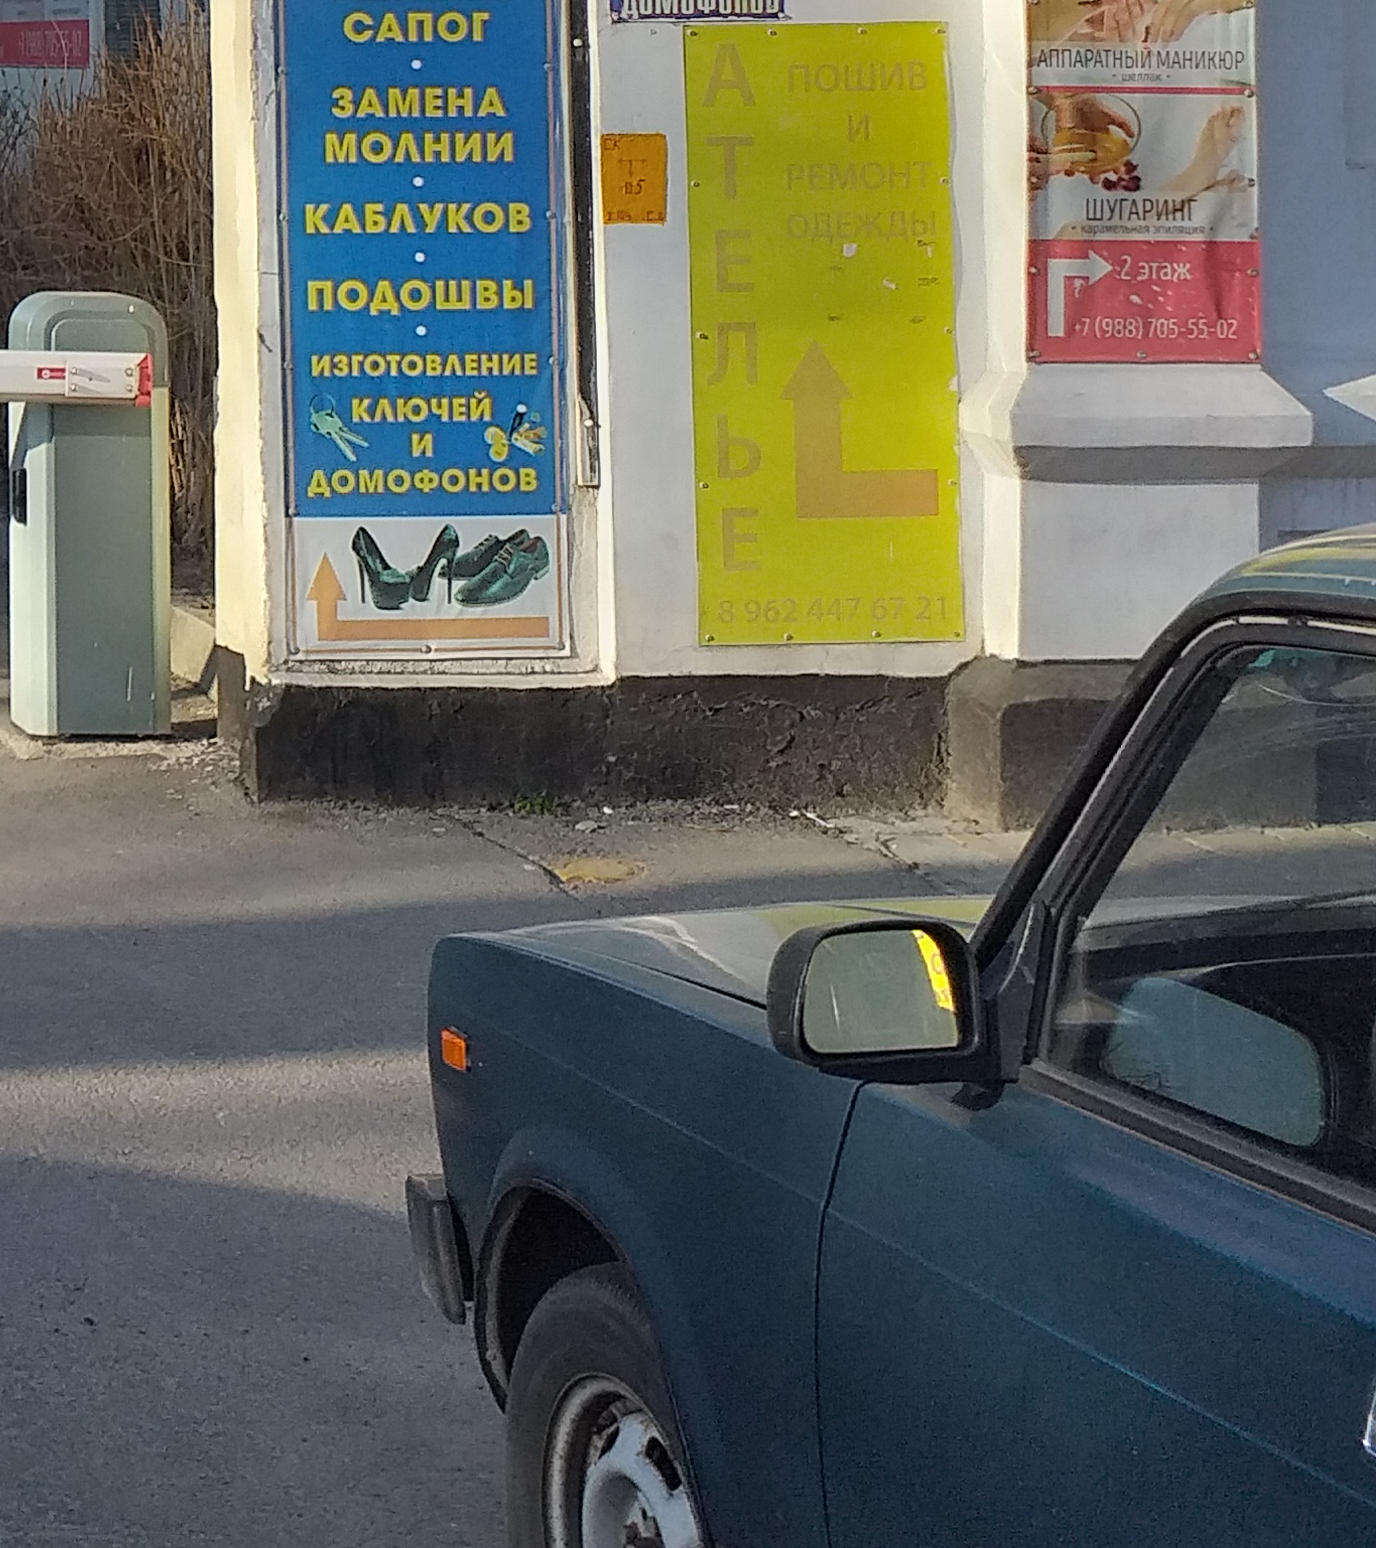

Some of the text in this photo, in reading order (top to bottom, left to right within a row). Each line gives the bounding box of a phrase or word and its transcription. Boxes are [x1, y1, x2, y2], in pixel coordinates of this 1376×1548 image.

[343, 11, 491, 43] САПОГ
[1037, 44, 1245, 70] АППАРАТНЫЙ МАНИКЮР
[786, 60, 928, 93] ПОШИВ
[331, 86, 507, 118] ЗАМЕНА
[849, 113, 871, 142] И
[324, 132, 514, 163] МОЛНИИ
[787, 161, 932, 193] РЕМОНТ
[304, 202, 531, 235] КАБЛУКОВ
[1085, 198, 1197, 222] ШУГАРИНГ
[787, 209, 937, 243] ОДЕЖДЫ
[1120, 255, 1191, 281] 2 этаж
[306, 278, 534, 317] ПОДОШВЫ
[701, 43, 762, 572] АТЕЛЬЕ
[1095, 317, 1143, 339] (988)
[1147, 318, 1238, 338] 705-55-02
[310, 352, 538, 377] ИЗГОТОВЛЕНИЕ
[351, 390, 492, 423] КЛЮЧЕЙ
[411, 432, 433, 457] И
[307, 468, 538, 498] ДОМОФОНОВ
[718, 595, 948, 624] 8 962 447 67 21
